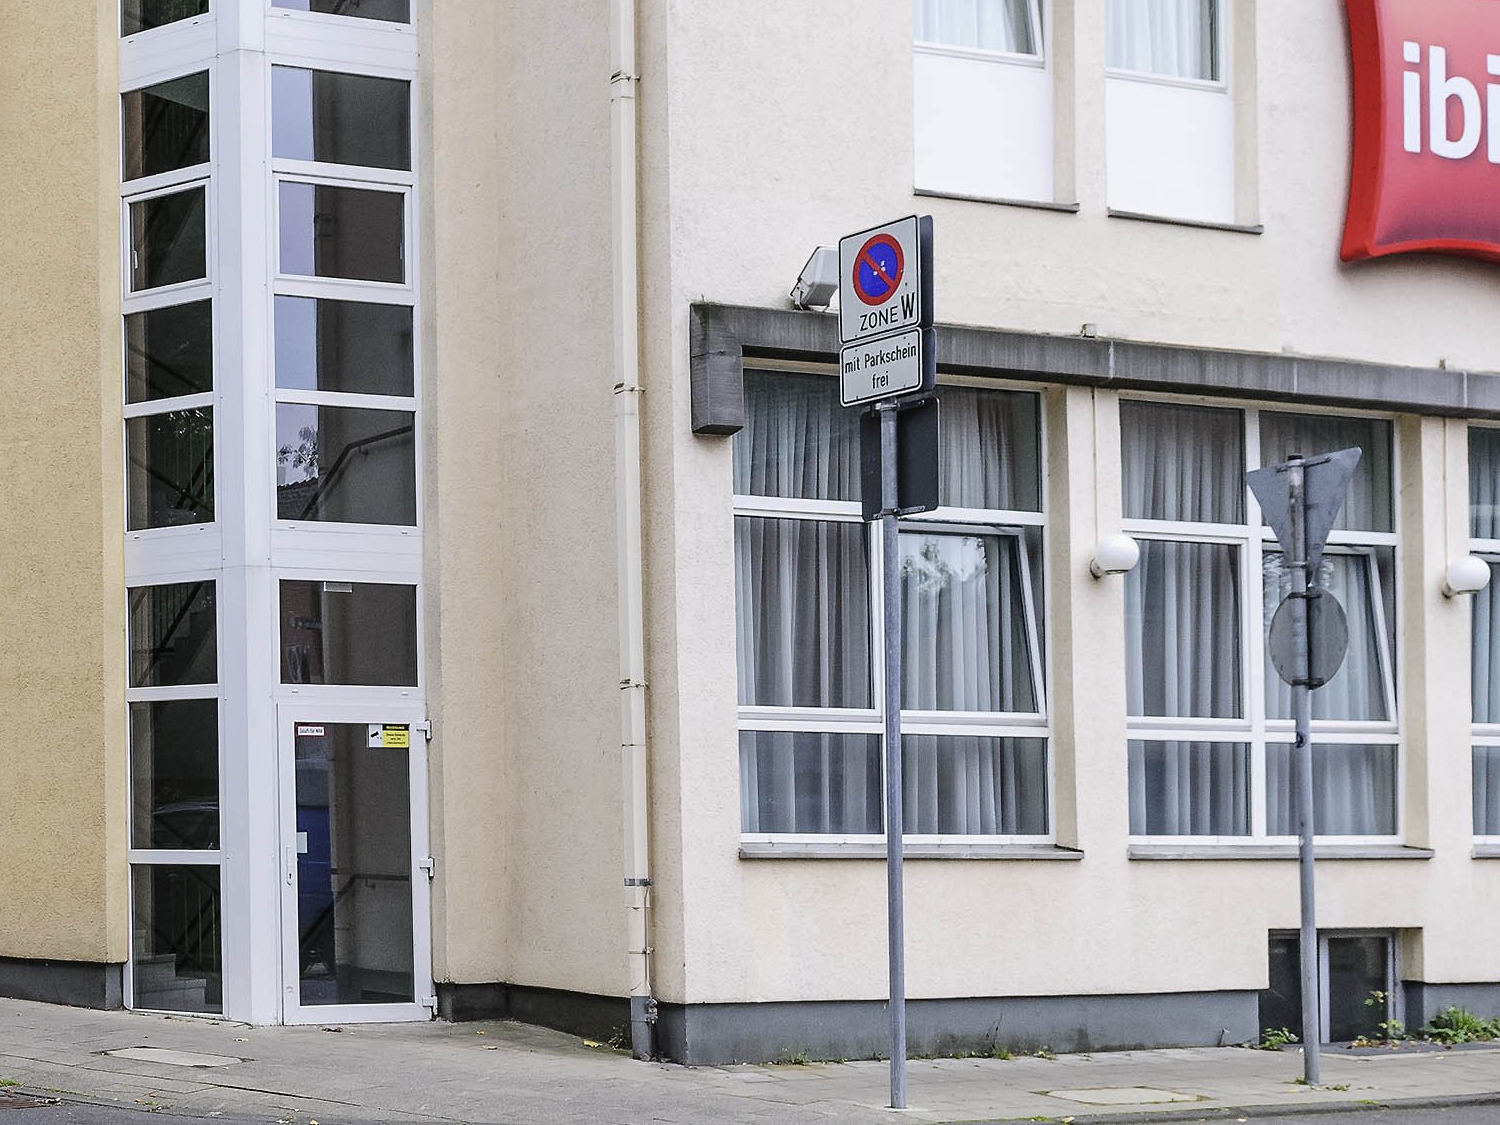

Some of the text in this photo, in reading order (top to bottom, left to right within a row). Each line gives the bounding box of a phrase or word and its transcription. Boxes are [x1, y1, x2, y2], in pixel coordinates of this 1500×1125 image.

[860, 291, 915, 331] ZONE W
[845, 342, 917, 373] mit Parkschein
[872, 370, 889, 389] frei
